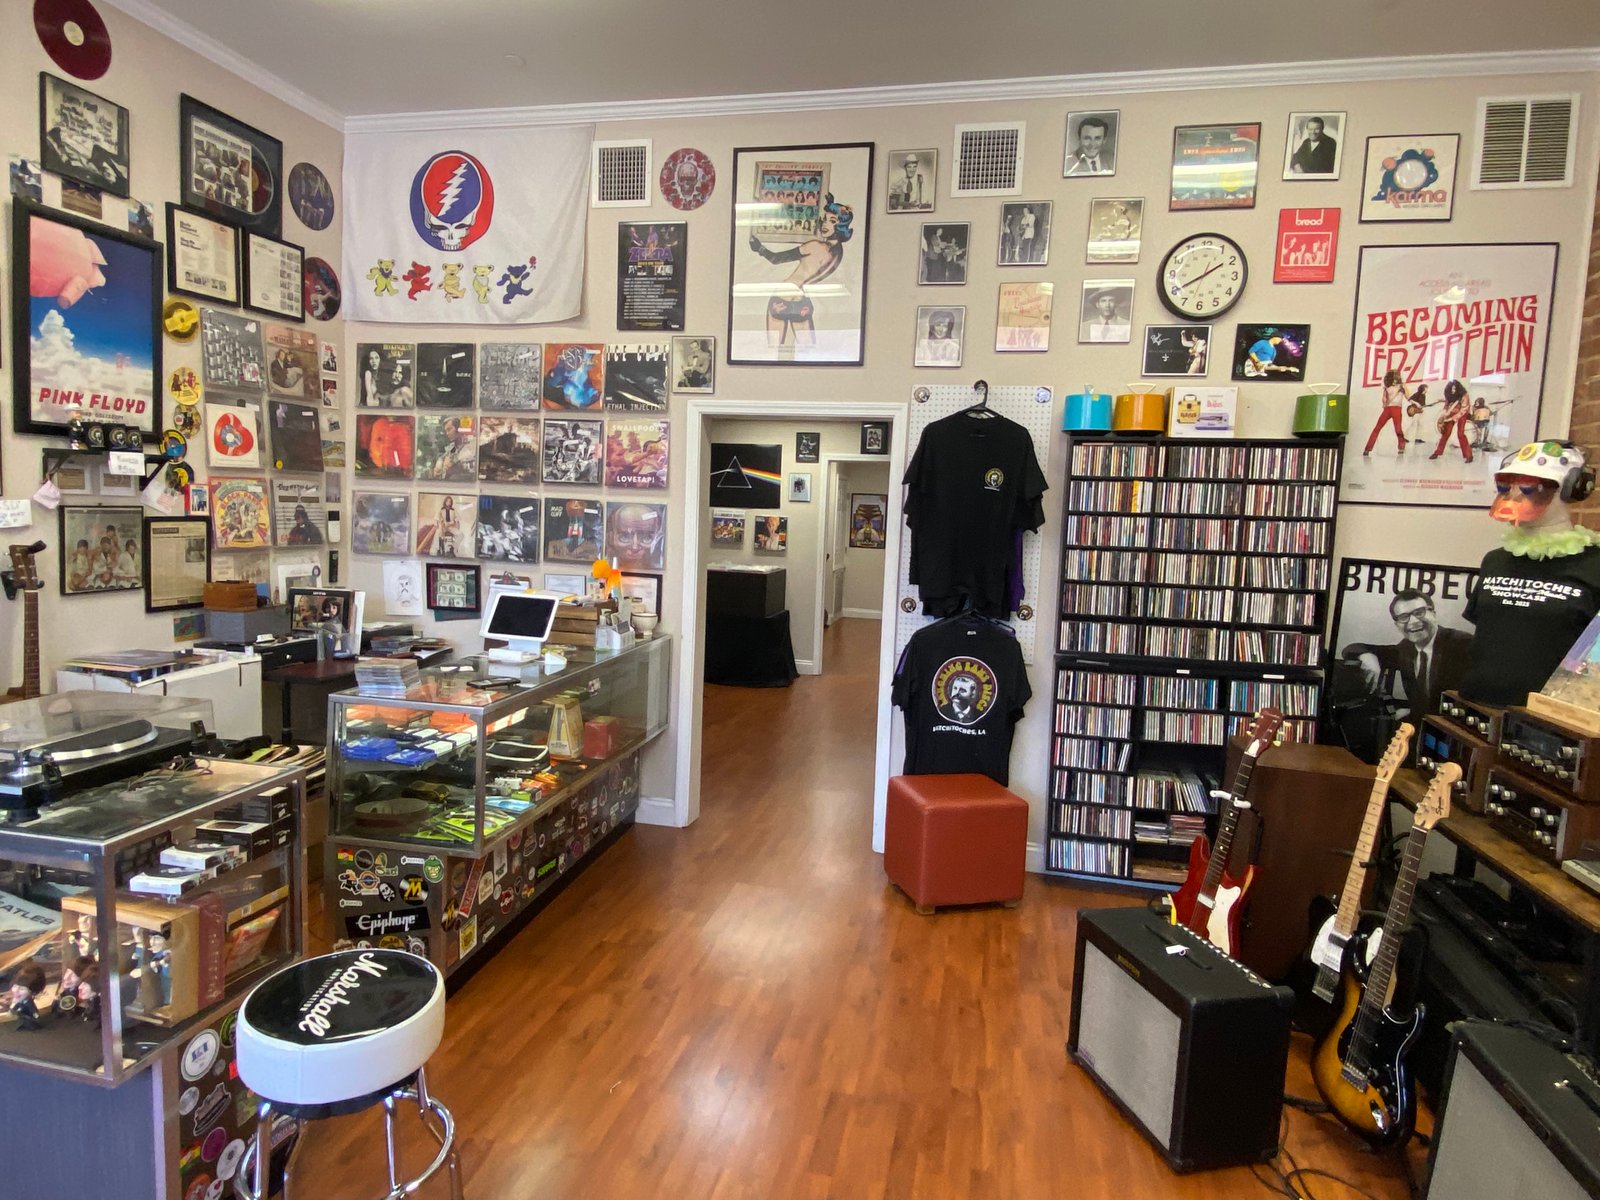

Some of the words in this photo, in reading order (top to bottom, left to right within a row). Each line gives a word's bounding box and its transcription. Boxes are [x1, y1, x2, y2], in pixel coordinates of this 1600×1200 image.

[1386, 187, 1448, 208] karma
[1296, 209, 1324, 226] bread
[1229, 256, 1236, 265] 2
[1169, 269, 1176, 279] 9
[1231, 271, 1238, 281] 3
[1225, 287, 1232, 296] 4
[1181, 297, 1188, 306] 7
[1196, 301, 1203, 310] 6
[1212, 297, 1219, 307] 5
[1366, 295, 1538, 345] BECOMING
[39, 388, 83, 407] PINK
[89, 394, 146, 414] FLOYD
[1483, 576, 1582, 597] NATCHITOCHES
[1492, 591, 1547, 602] SHOWCASE
[356, 911, 416, 936] Epiphone
[298, 952, 388, 1037] Marshall
